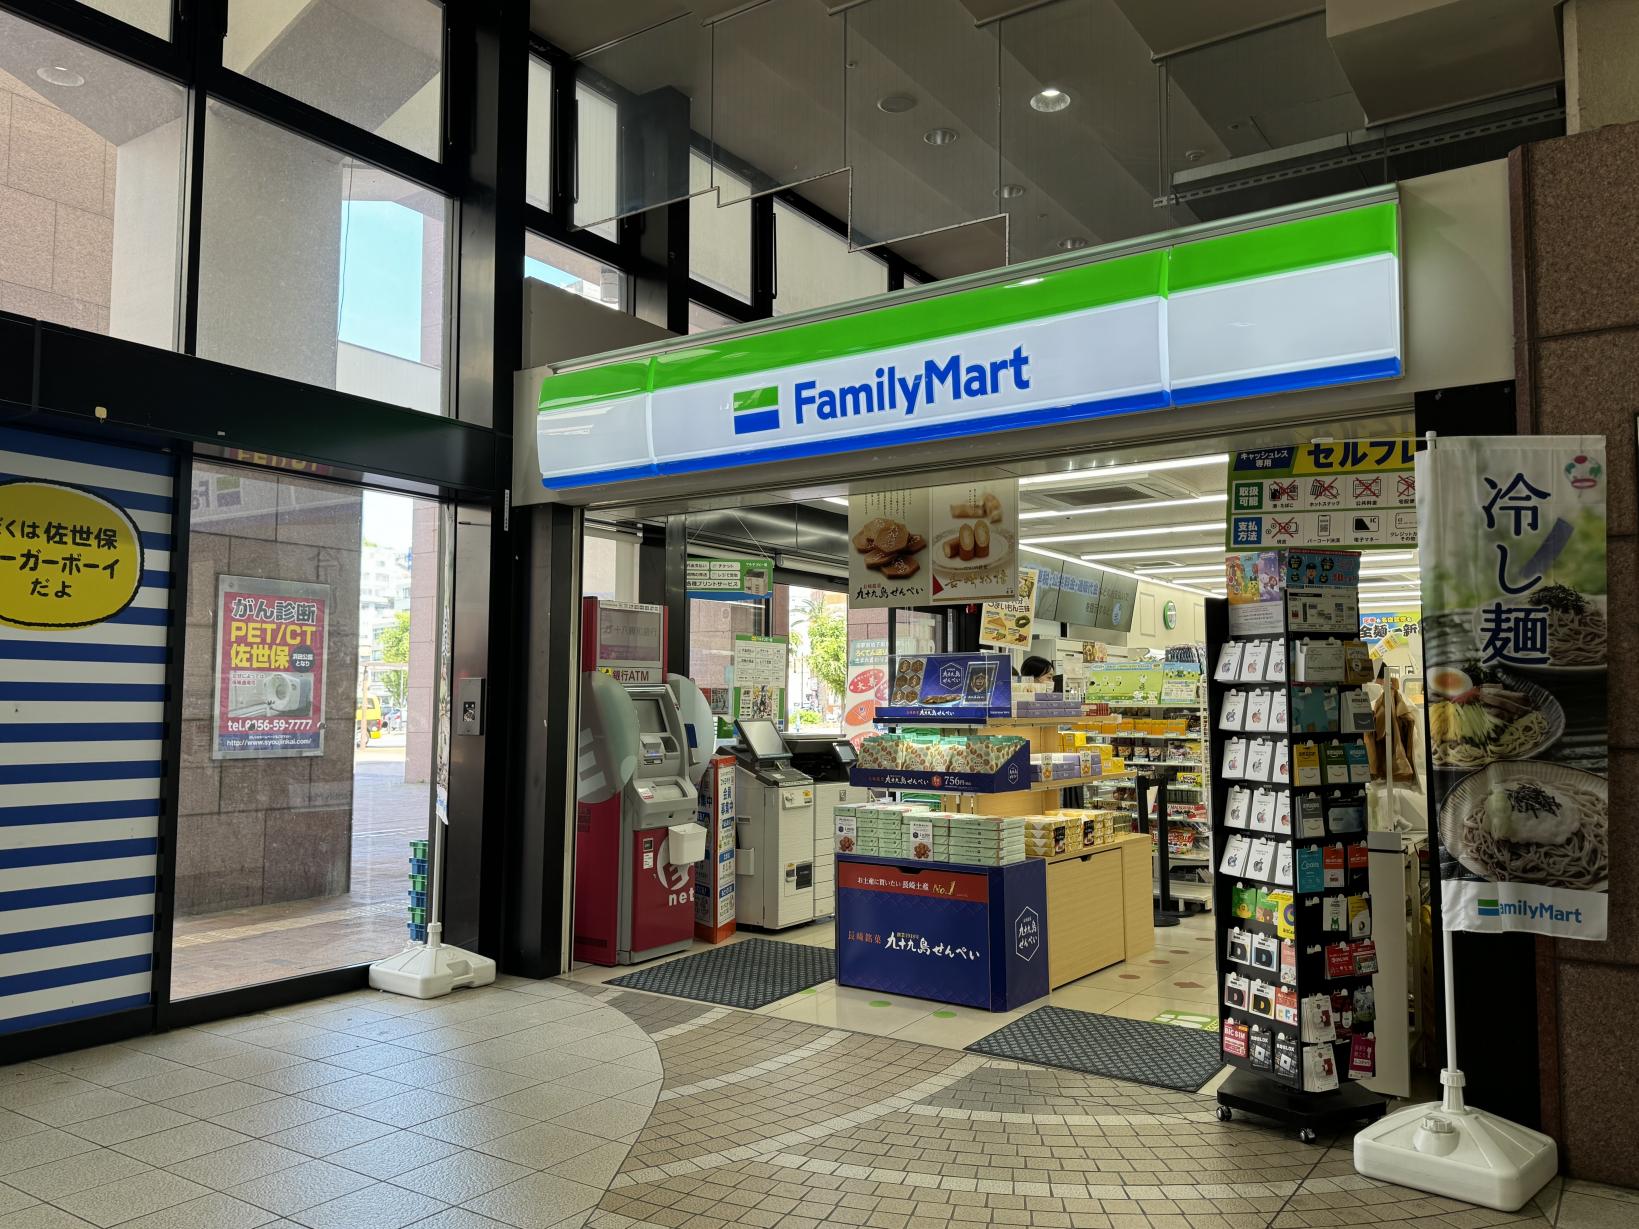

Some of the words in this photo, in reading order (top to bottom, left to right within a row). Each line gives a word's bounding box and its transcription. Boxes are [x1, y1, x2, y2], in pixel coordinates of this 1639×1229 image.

[794, 345, 1030, 424] FamilyMart
[1241, 449, 1288, 459] キャッシュレス
[1480, 472, 1551, 665] 冷し麺
[30, 578, 72, 598] だよ
[855, 585, 924, 600] 九十九島せんべい
[231, 597, 317, 624] がん診断
[230, 621, 316, 645] PET/CT
[230, 643, 289, 669] 佐世保
[612, 669, 650, 683] 銀行ATM
[884, 775, 929, 785] 九十九島せんべい
[668, 887, 695, 906] net
[933, 880, 956, 896] No.1
[1499, 900, 1582, 923] amilyMart
[1018, 919, 1037, 937] 九十九島
[884, 931, 980, 960] 九十九島せんべい
[1018, 934, 1038, 949] せんべい
